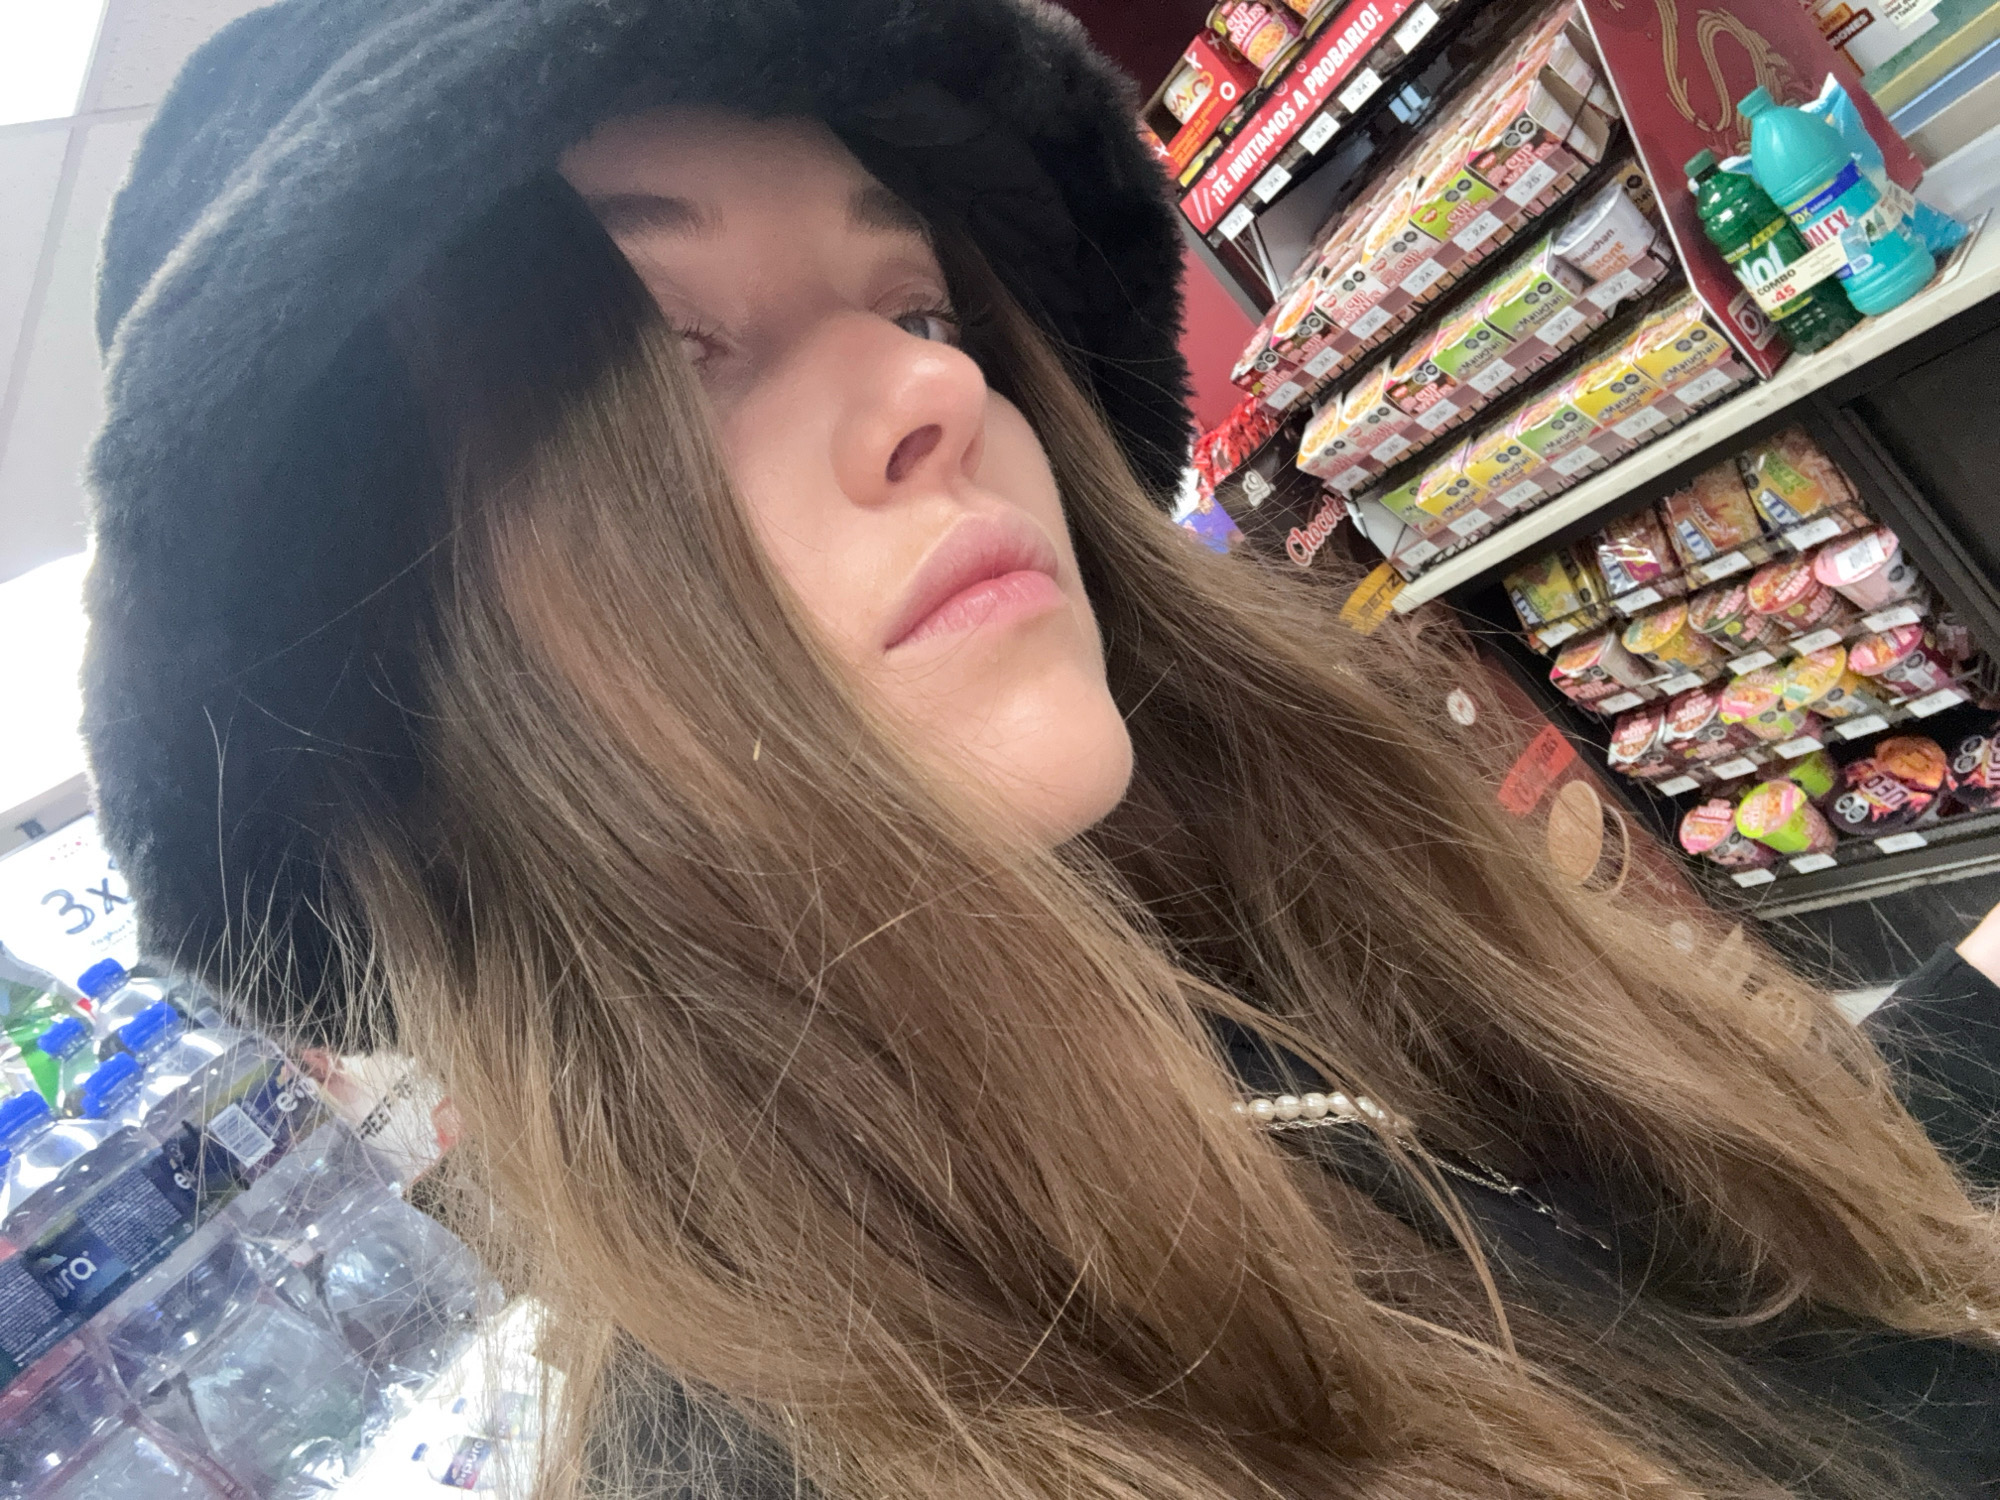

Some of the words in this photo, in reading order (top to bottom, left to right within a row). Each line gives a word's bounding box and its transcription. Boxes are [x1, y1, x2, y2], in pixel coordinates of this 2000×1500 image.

[1226, 2, 1249, 31] CUP
[1211, 174, 1233, 207] ¡TE
[1227, 101, 1297, 183] INVITAMOS
[1292, 89, 1310, 111] A
[1303, 2, 1384, 97] PROBARLO!
[1505, 142, 1534, 169] CUP
[1757, 268, 1797, 296] COMBO
[1518, 294, 1564, 327] Maruchan
[1460, 339, 1502, 374] Maruchan
[1667, 341, 1719, 374] Maruchan
[1604, 385, 1651, 416] Maruchan
[1546, 422, 1590, 453] Maruchan
